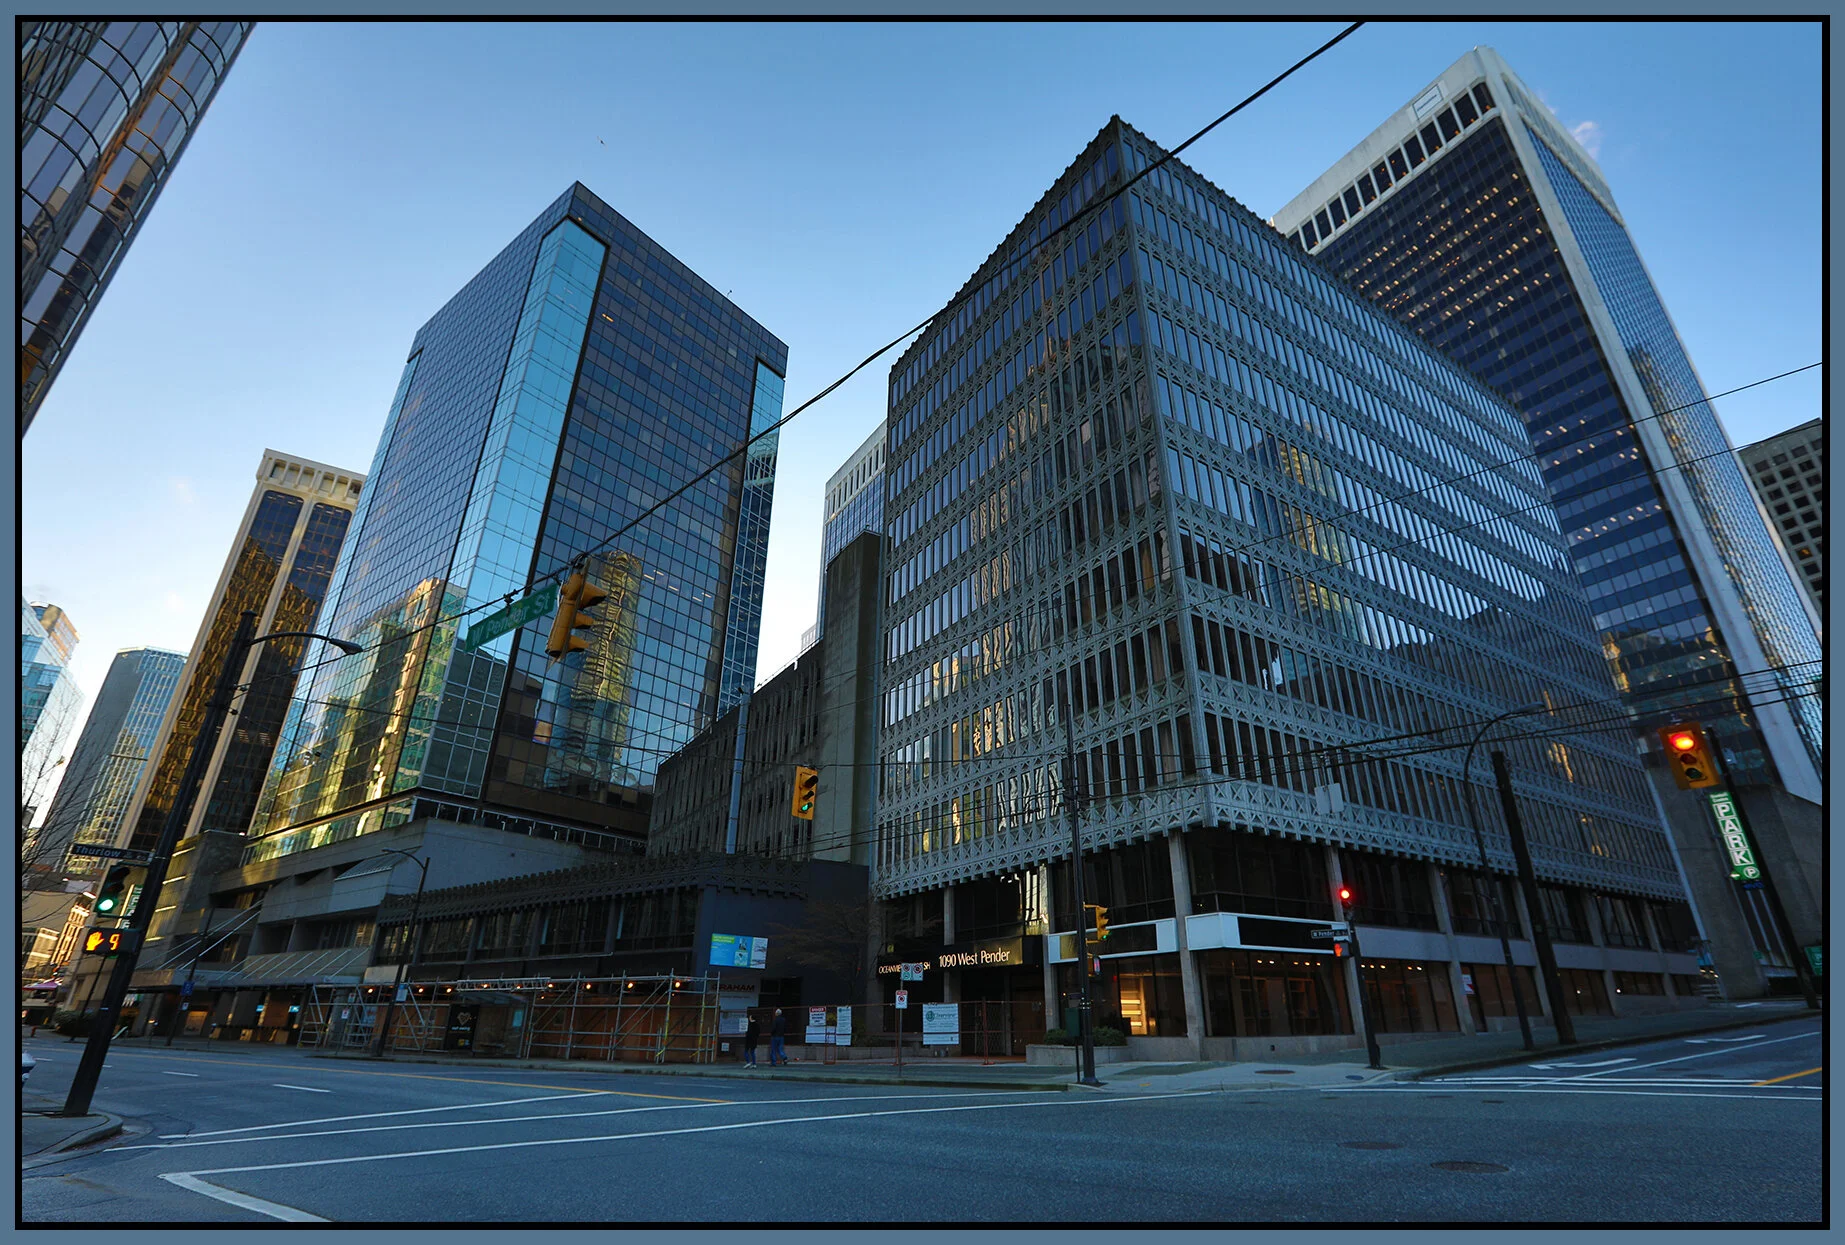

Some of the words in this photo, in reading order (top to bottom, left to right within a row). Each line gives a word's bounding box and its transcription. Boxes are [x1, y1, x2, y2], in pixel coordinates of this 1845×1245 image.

[472, 625, 484, 647] W
[486, 603, 531, 640] Pender
[533, 592, 551, 614] St
[1716, 803, 1751, 865] PARK
[75, 845, 121, 858] Thurlow
[109, 933, 120, 951] 9
[939, 954, 957, 968] 1090
[957, 952, 978, 966] West
[980, 947, 1011, 964] Pender
